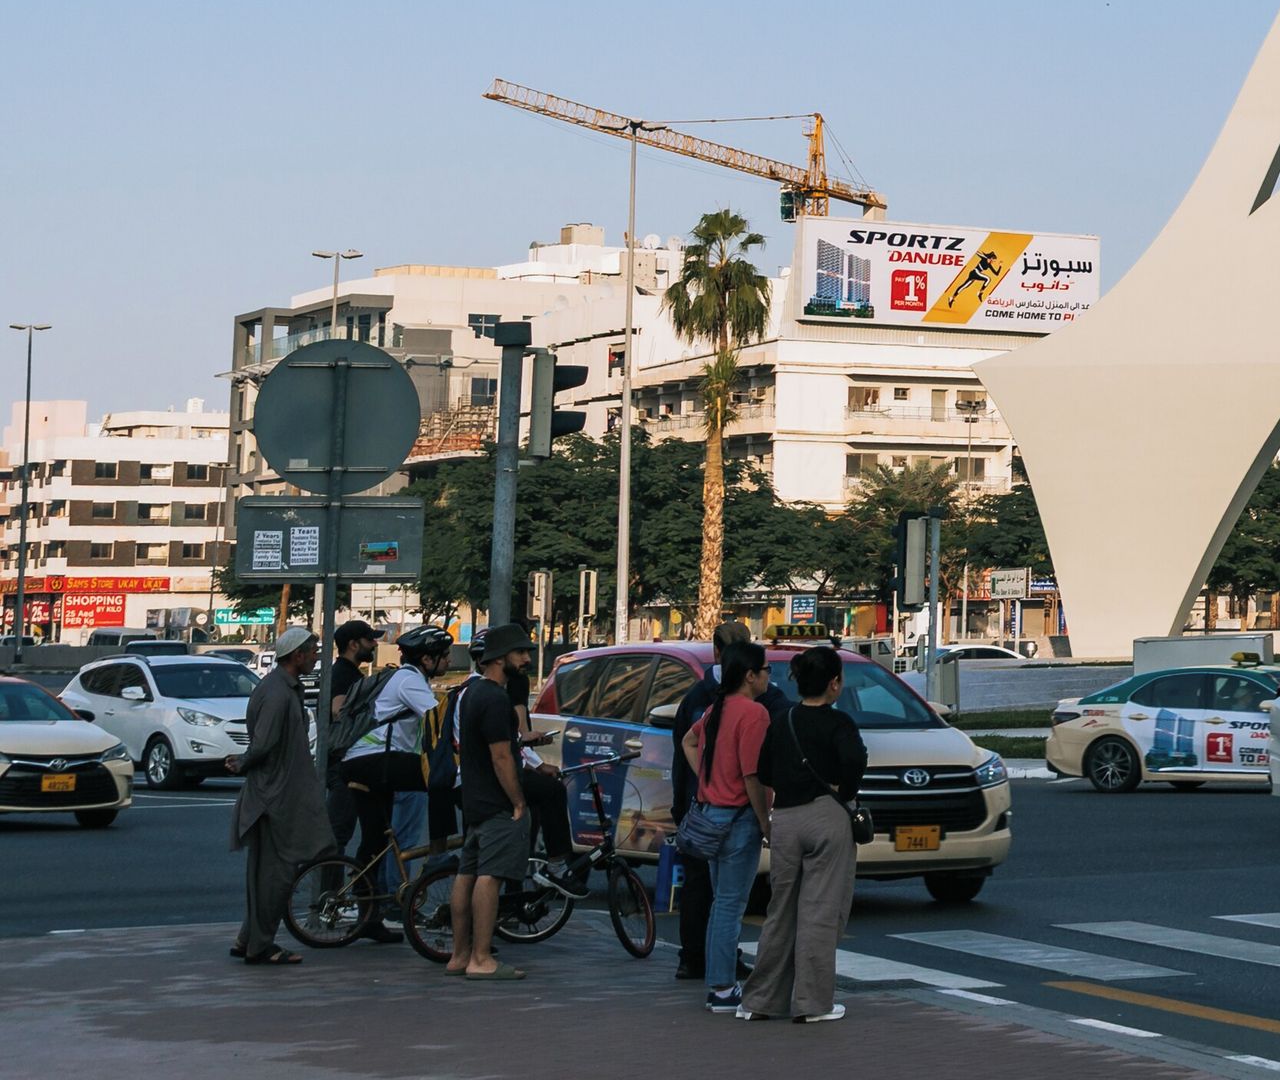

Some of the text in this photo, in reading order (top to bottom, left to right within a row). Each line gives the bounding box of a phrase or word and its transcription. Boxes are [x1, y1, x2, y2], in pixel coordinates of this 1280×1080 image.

[847, 229, 966, 251] SPORTZ
[888, 249, 966, 267] DANUBE
[1021, 252, 1093, 278] سبورتز
[1021, 280, 1070, 292] دانوب
[987, 297, 1015, 308] الرياضة
[1045, 301, 1069, 311] المنزل
[985, 309, 1015, 319] COME
[1016, 311, 1047, 320] HOME
[1048, 312, 1062, 321] TO
[65, 595, 123, 606] SHOPPING
[77, 609, 94, 617] Aed
[65, 617, 95, 626] PER Kg
[781, 626, 820, 636] TAXI
[1240, 753, 1255, 763] TO
